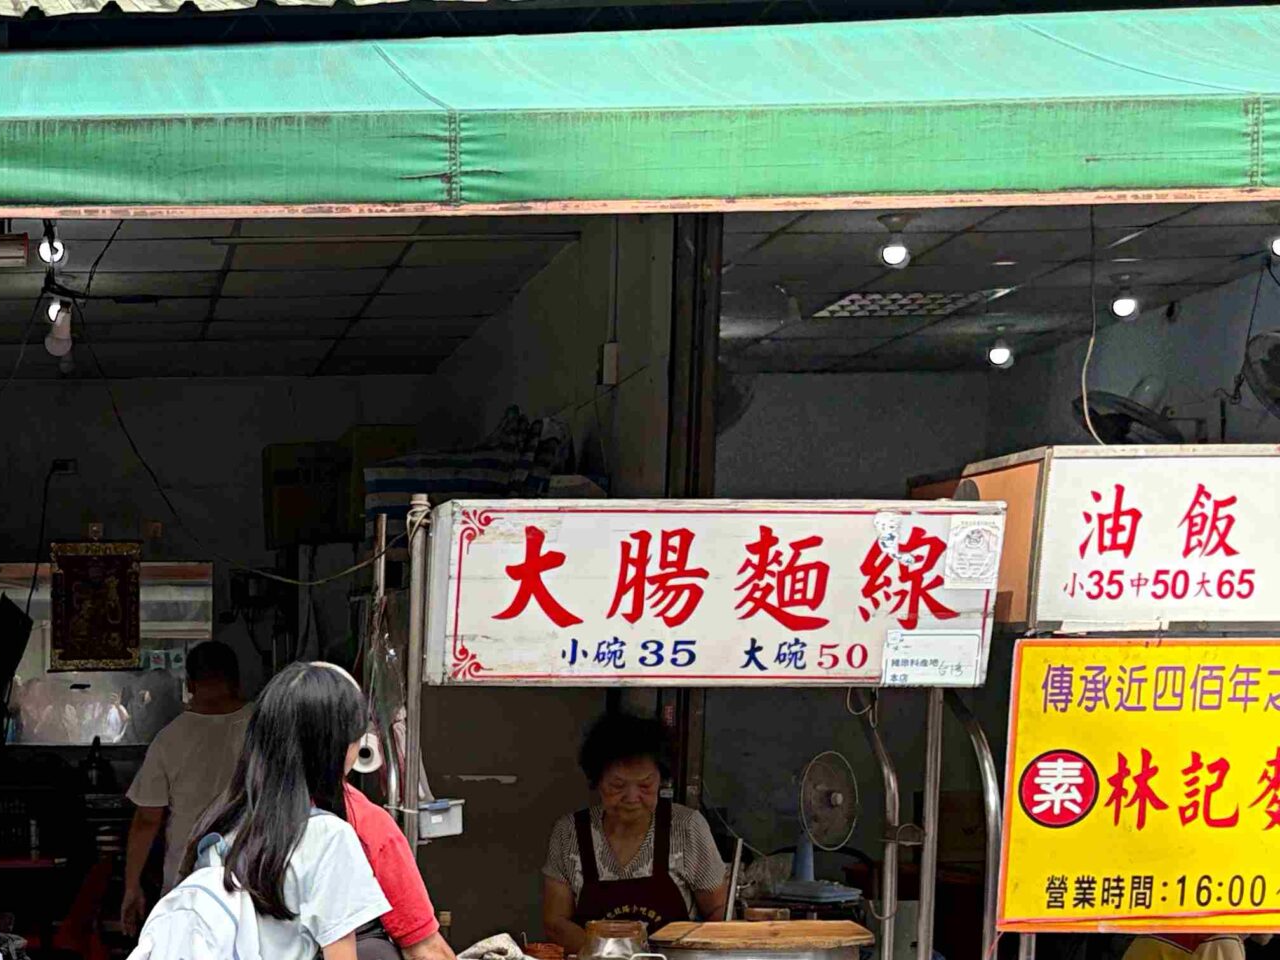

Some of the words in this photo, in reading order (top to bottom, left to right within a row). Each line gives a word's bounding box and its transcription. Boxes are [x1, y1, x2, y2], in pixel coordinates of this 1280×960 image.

[1079, 484, 1240, 558] 油飯
[491, 525, 960, 631] 大腸麵線
[561, 636, 627, 669] 小碗
[638, 639, 697, 667] 35
[740, 637, 807, 671] 大碗
[816, 643, 869, 669] 50
[1031, 758, 1084, 816] 素
